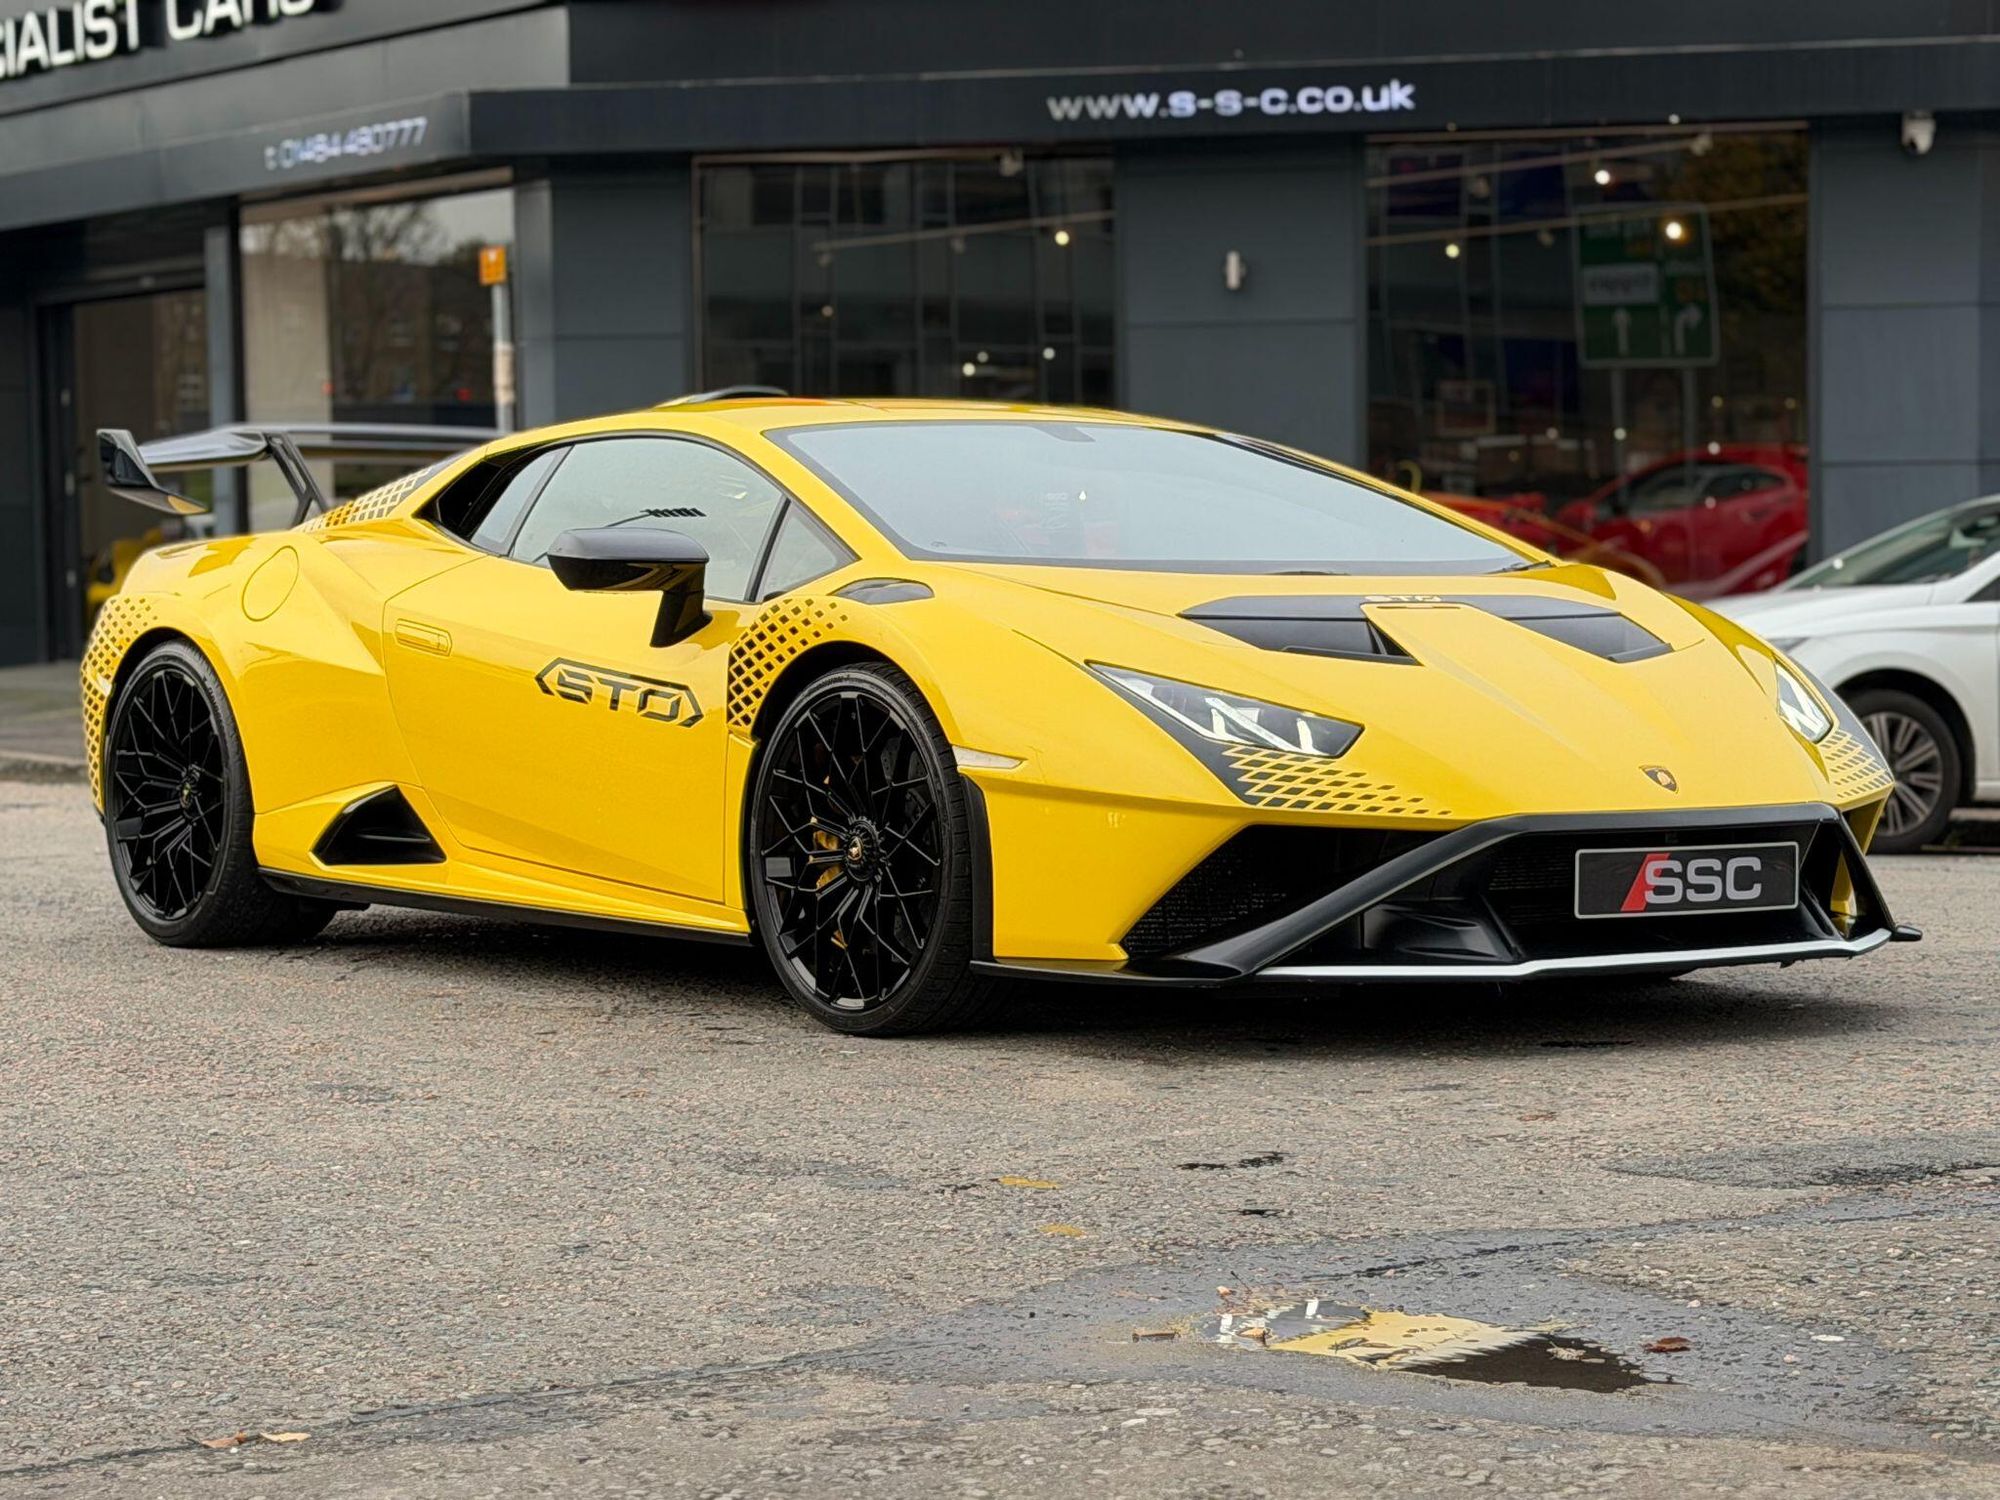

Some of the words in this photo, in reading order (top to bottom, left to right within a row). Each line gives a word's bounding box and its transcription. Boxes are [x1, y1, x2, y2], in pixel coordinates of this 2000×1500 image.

[0, 0, 140, 78] IALIST
[1046, 79, 1415, 121] www.s-s-c.co.uk
[556, 668, 683, 723] STO
[1644, 856, 1762, 904] SSC
